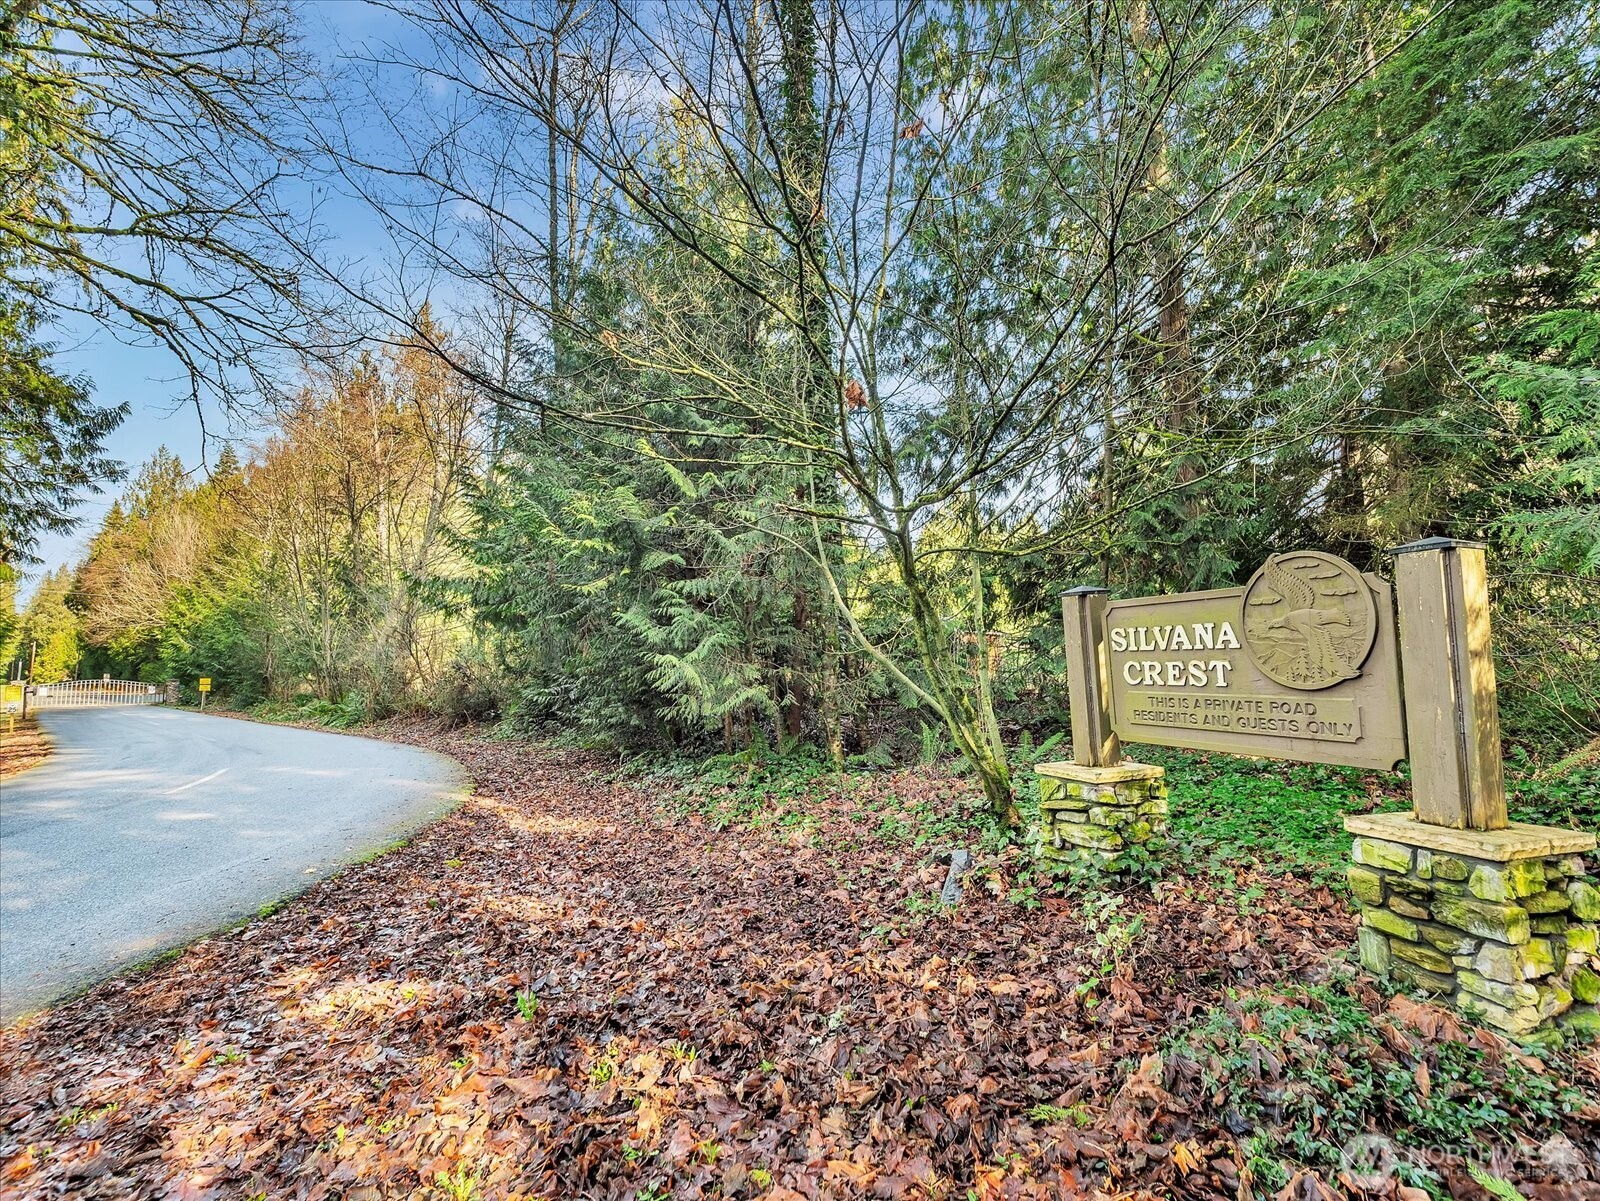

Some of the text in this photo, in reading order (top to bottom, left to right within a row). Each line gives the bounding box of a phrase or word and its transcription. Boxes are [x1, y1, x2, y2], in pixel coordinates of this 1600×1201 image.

[1110, 621, 1241, 652] SILVANA
[1122, 660, 1233, 687] CREST
[1147, 696, 1317, 716] THIS IS A PRIVATE ROAD
[1133, 709, 1353, 737] RESIDENTS AND GUESTS ONLY
